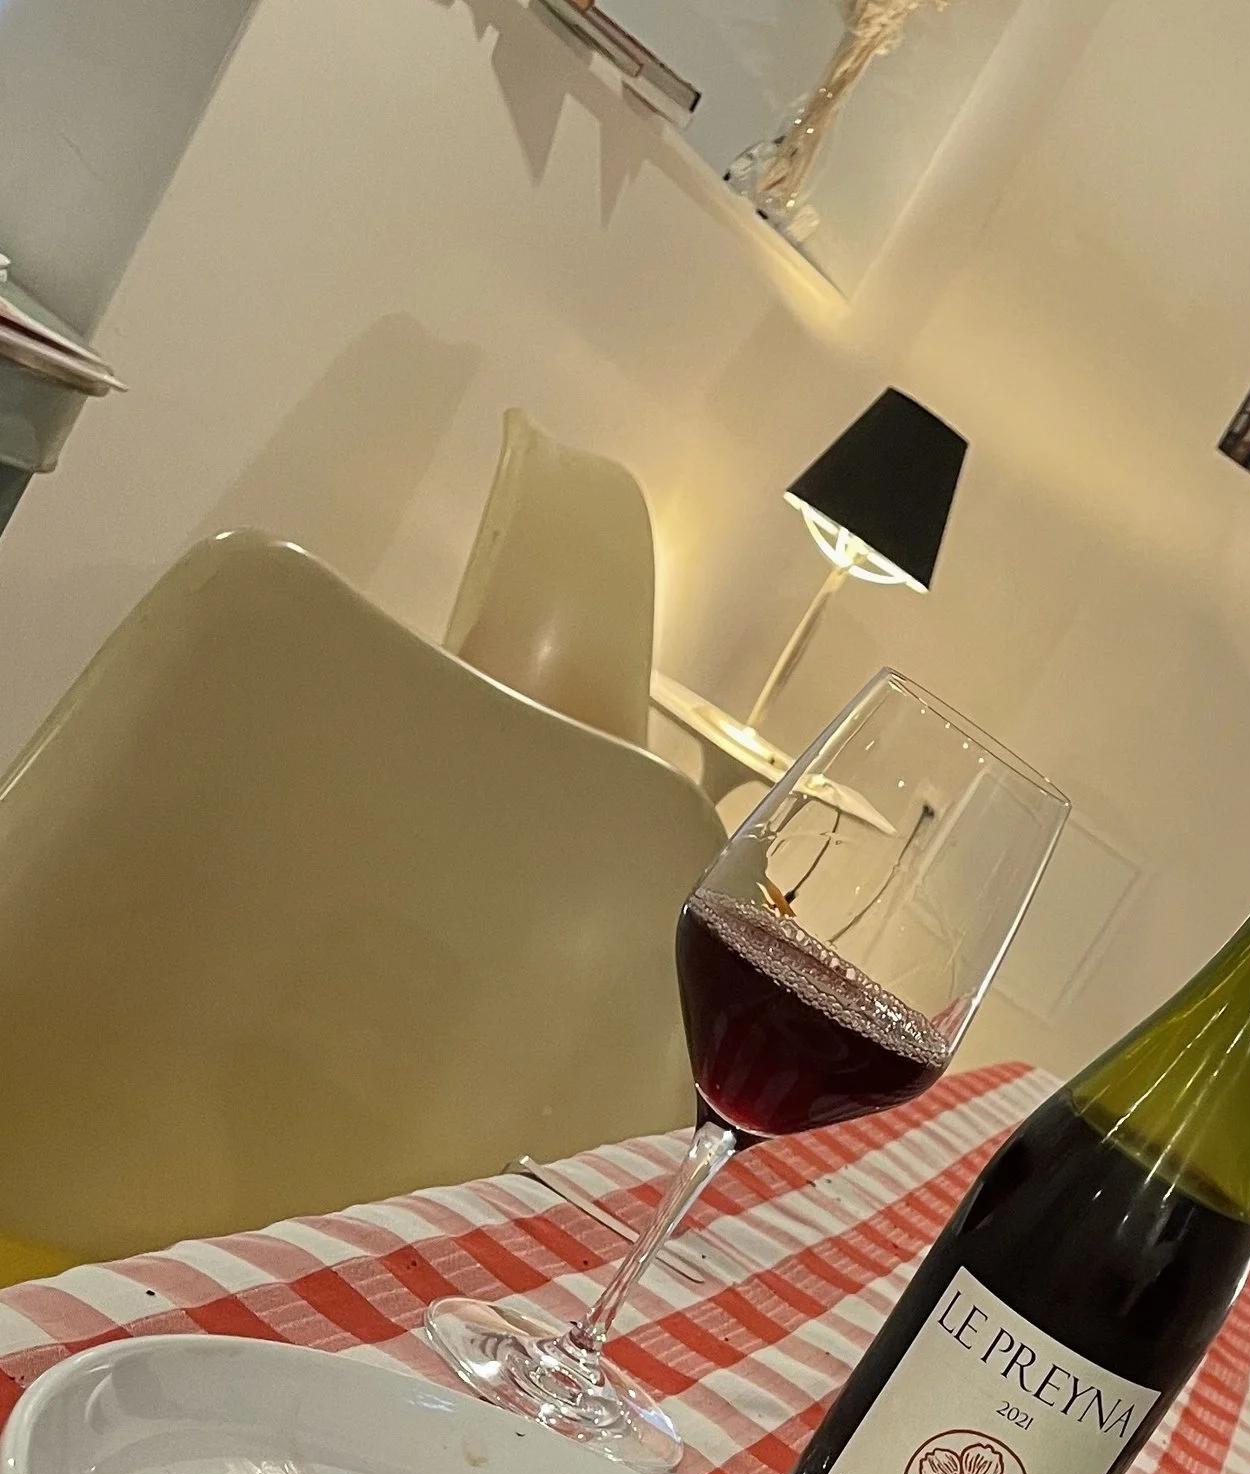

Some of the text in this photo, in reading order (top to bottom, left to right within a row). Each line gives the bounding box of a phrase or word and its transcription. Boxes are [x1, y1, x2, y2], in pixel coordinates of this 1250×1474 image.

[937, 1290, 1135, 1438] LE PREYNA
[996, 1401, 1034, 1430] 2021
